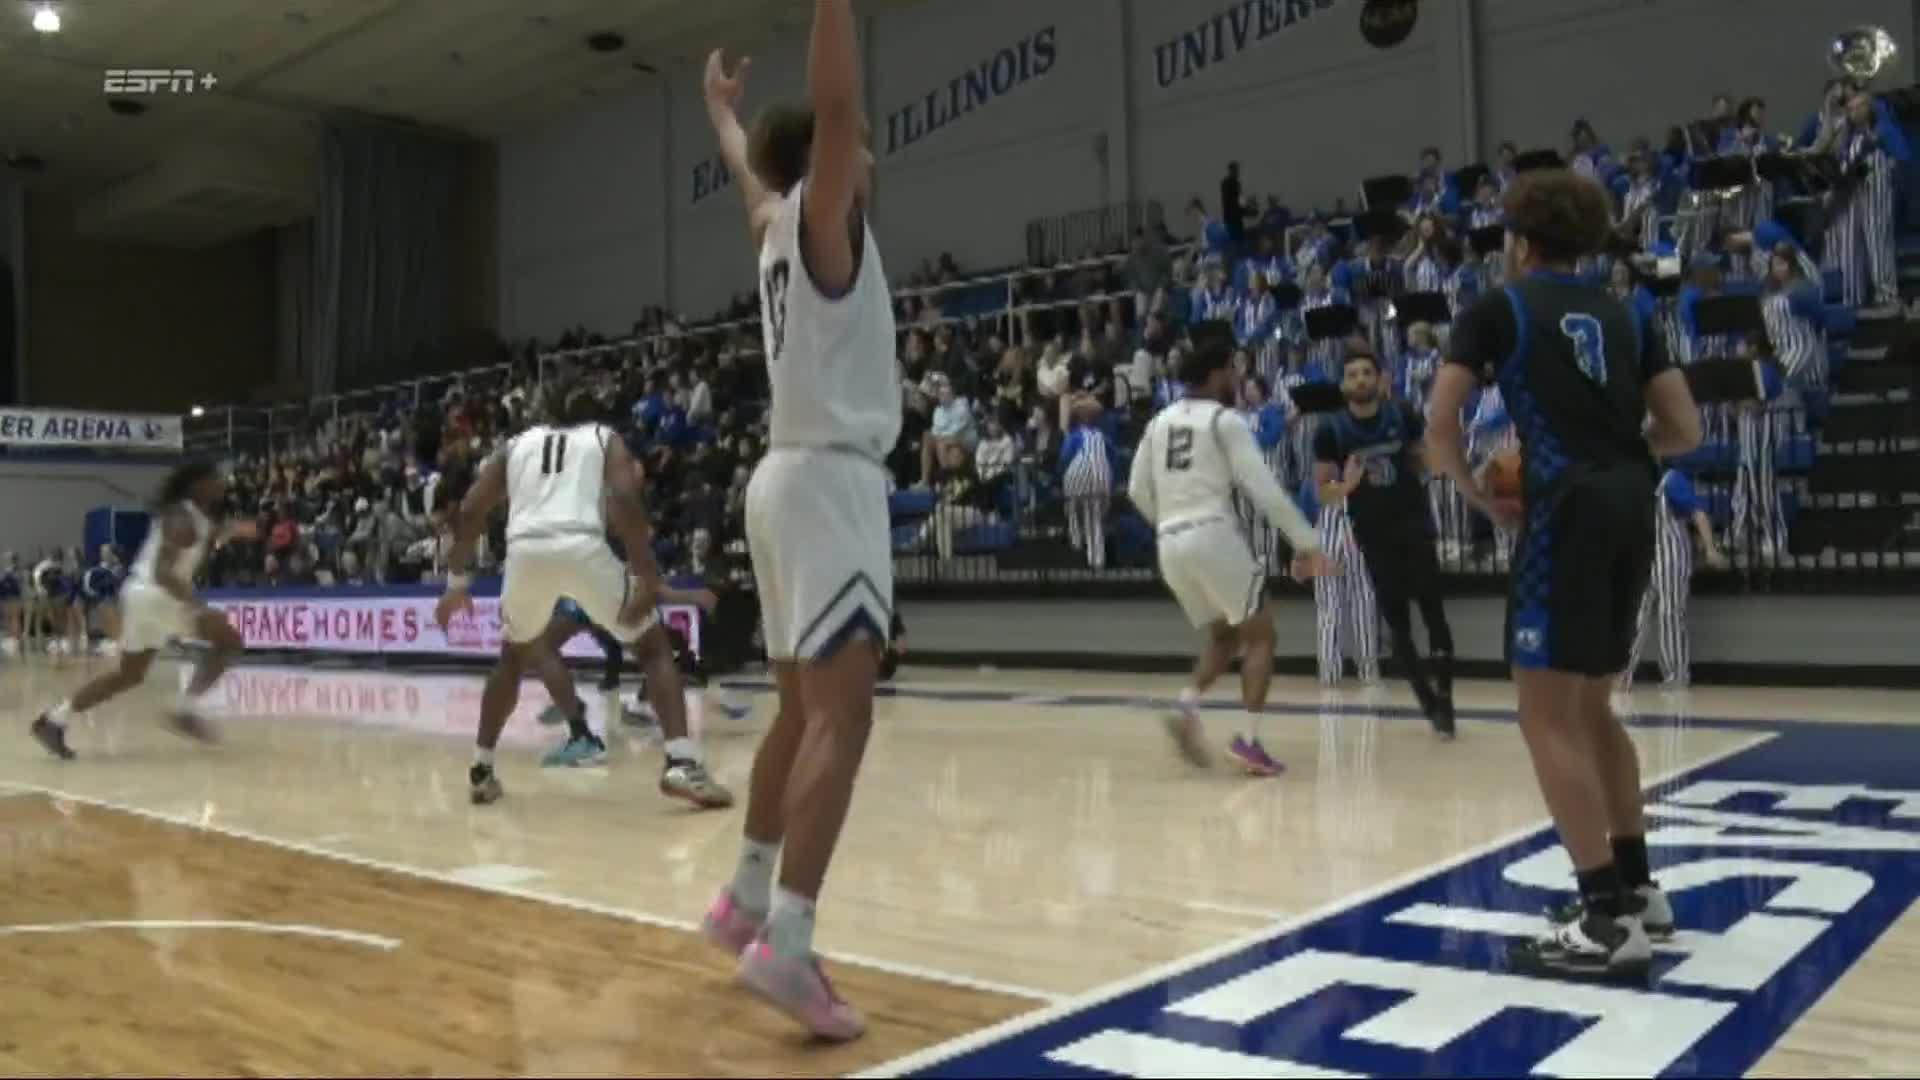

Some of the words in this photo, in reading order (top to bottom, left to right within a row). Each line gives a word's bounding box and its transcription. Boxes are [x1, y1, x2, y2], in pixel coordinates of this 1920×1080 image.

[1154, 0, 1335, 88] UNIVER
[887, 24, 1057, 156] ILLINOIS
[42, 416, 132, 440] ARENA
[541, 434, 567, 474] 11
